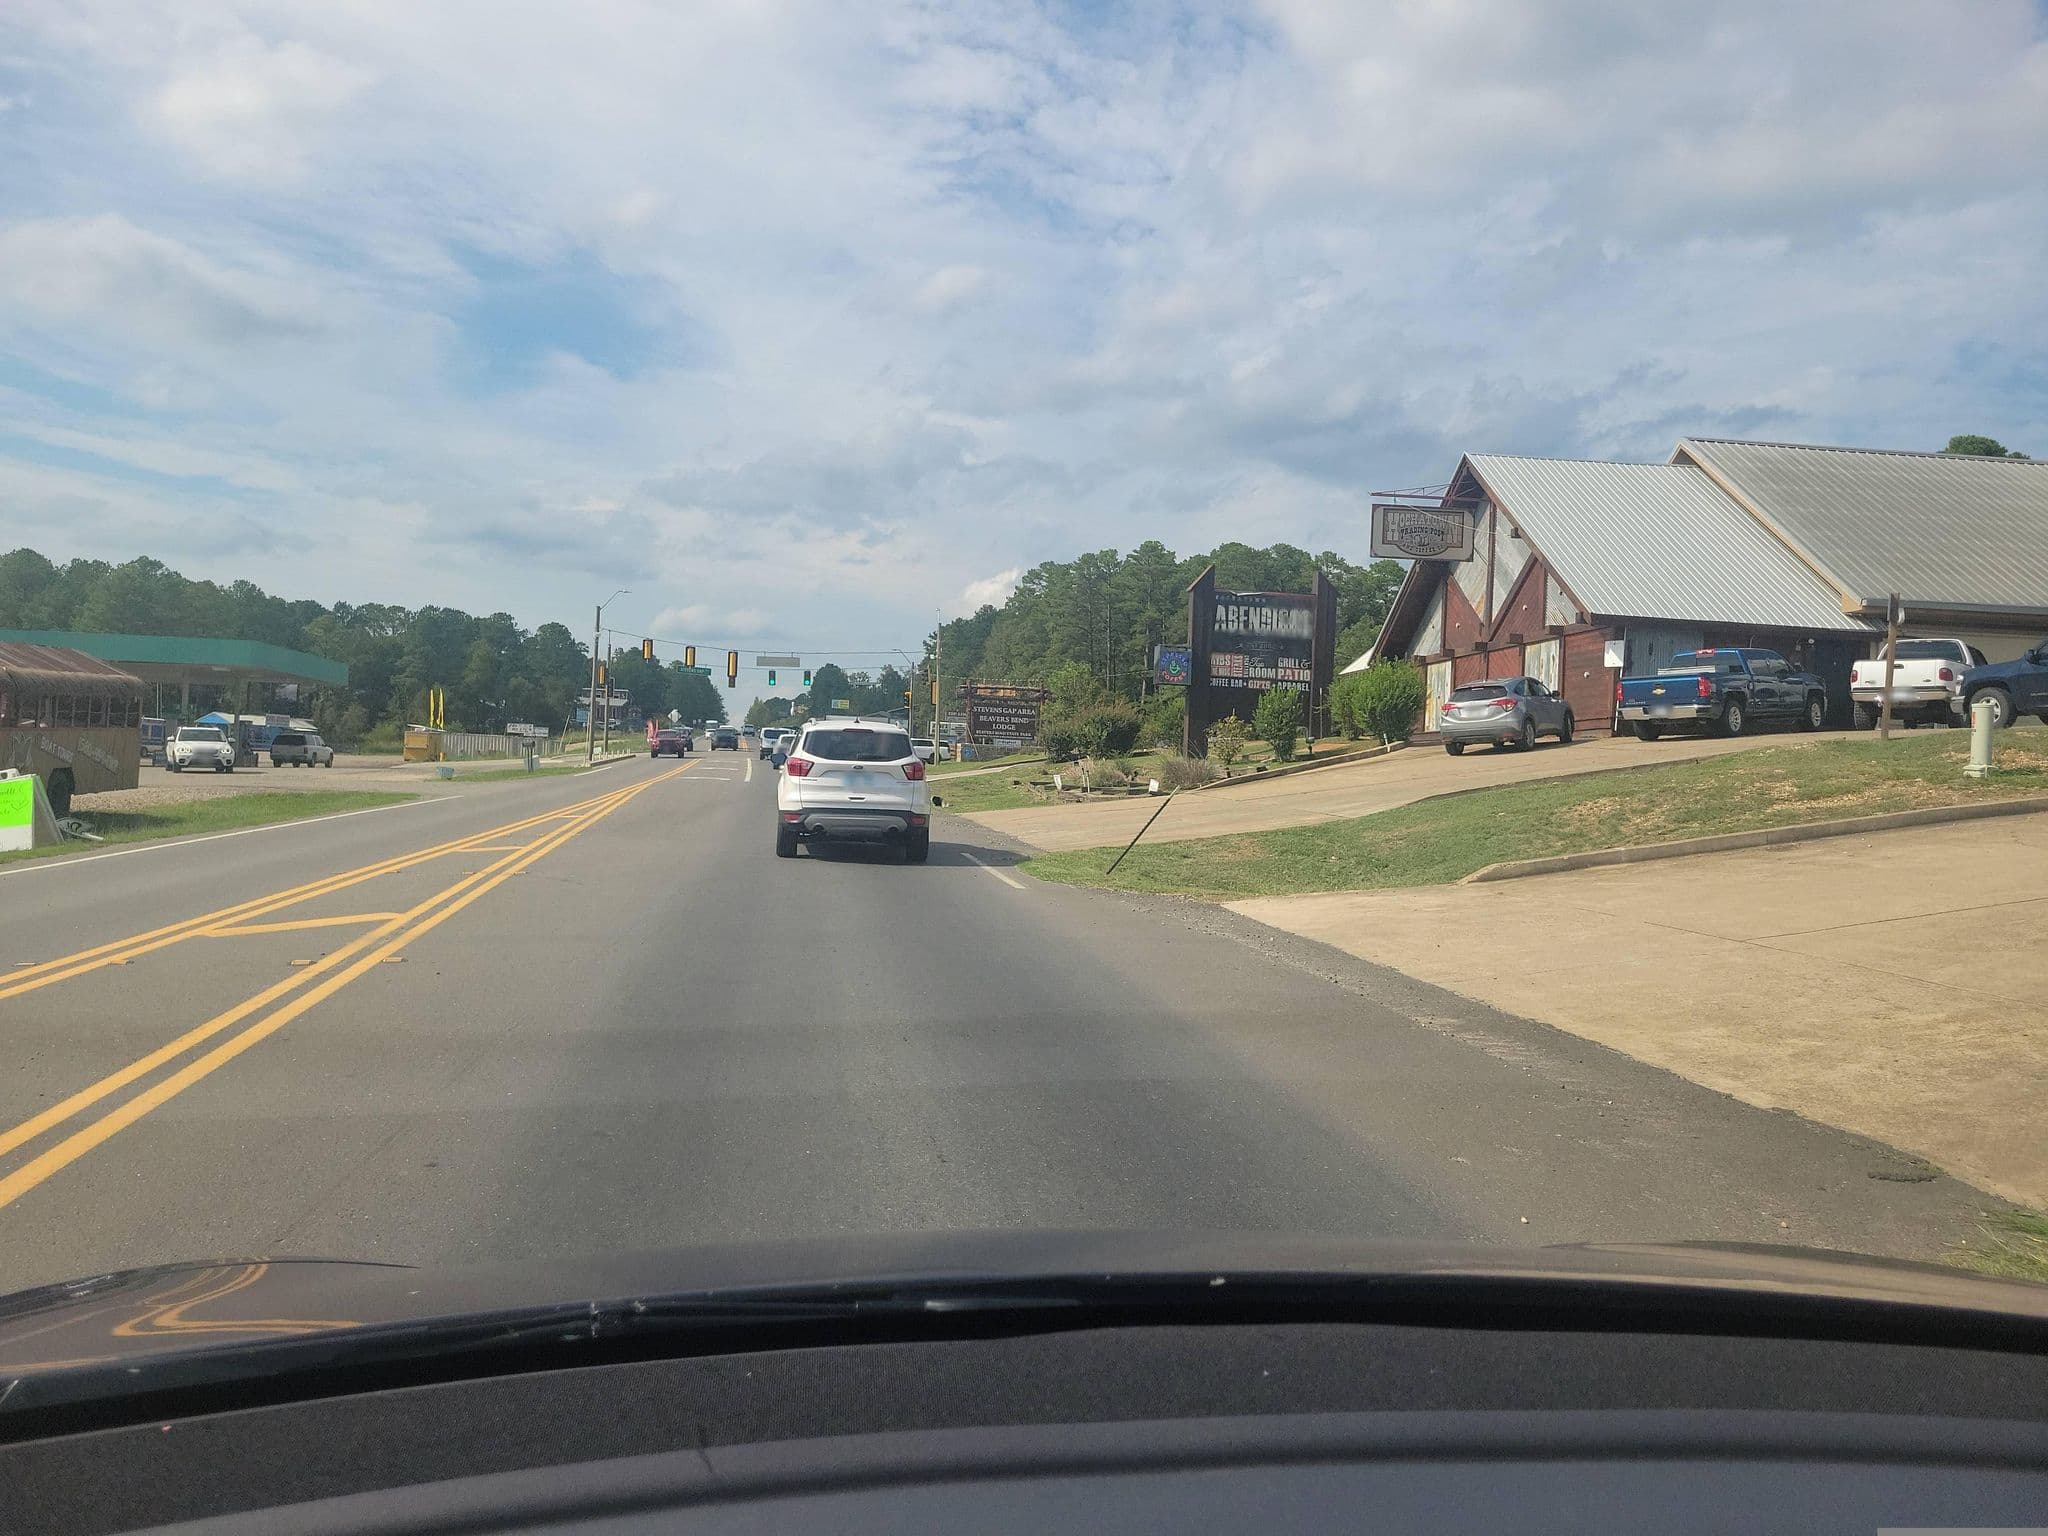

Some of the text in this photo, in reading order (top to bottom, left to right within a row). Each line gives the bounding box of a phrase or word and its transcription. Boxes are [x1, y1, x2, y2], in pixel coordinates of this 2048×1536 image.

[1400, 526, 1445, 541] TRADING POST
[1277, 657, 1311, 669] GRILL &
[1249, 667, 1276, 679] ROOM
[1277, 668, 1311, 681] PATIO
[1209, 677, 1243, 688] COFFEE BAR
[1248, 680, 1271, 689] GIFTS
[1277, 681, 1310, 692] APPAREL
[973, 706, 1003, 714] STEVENS
